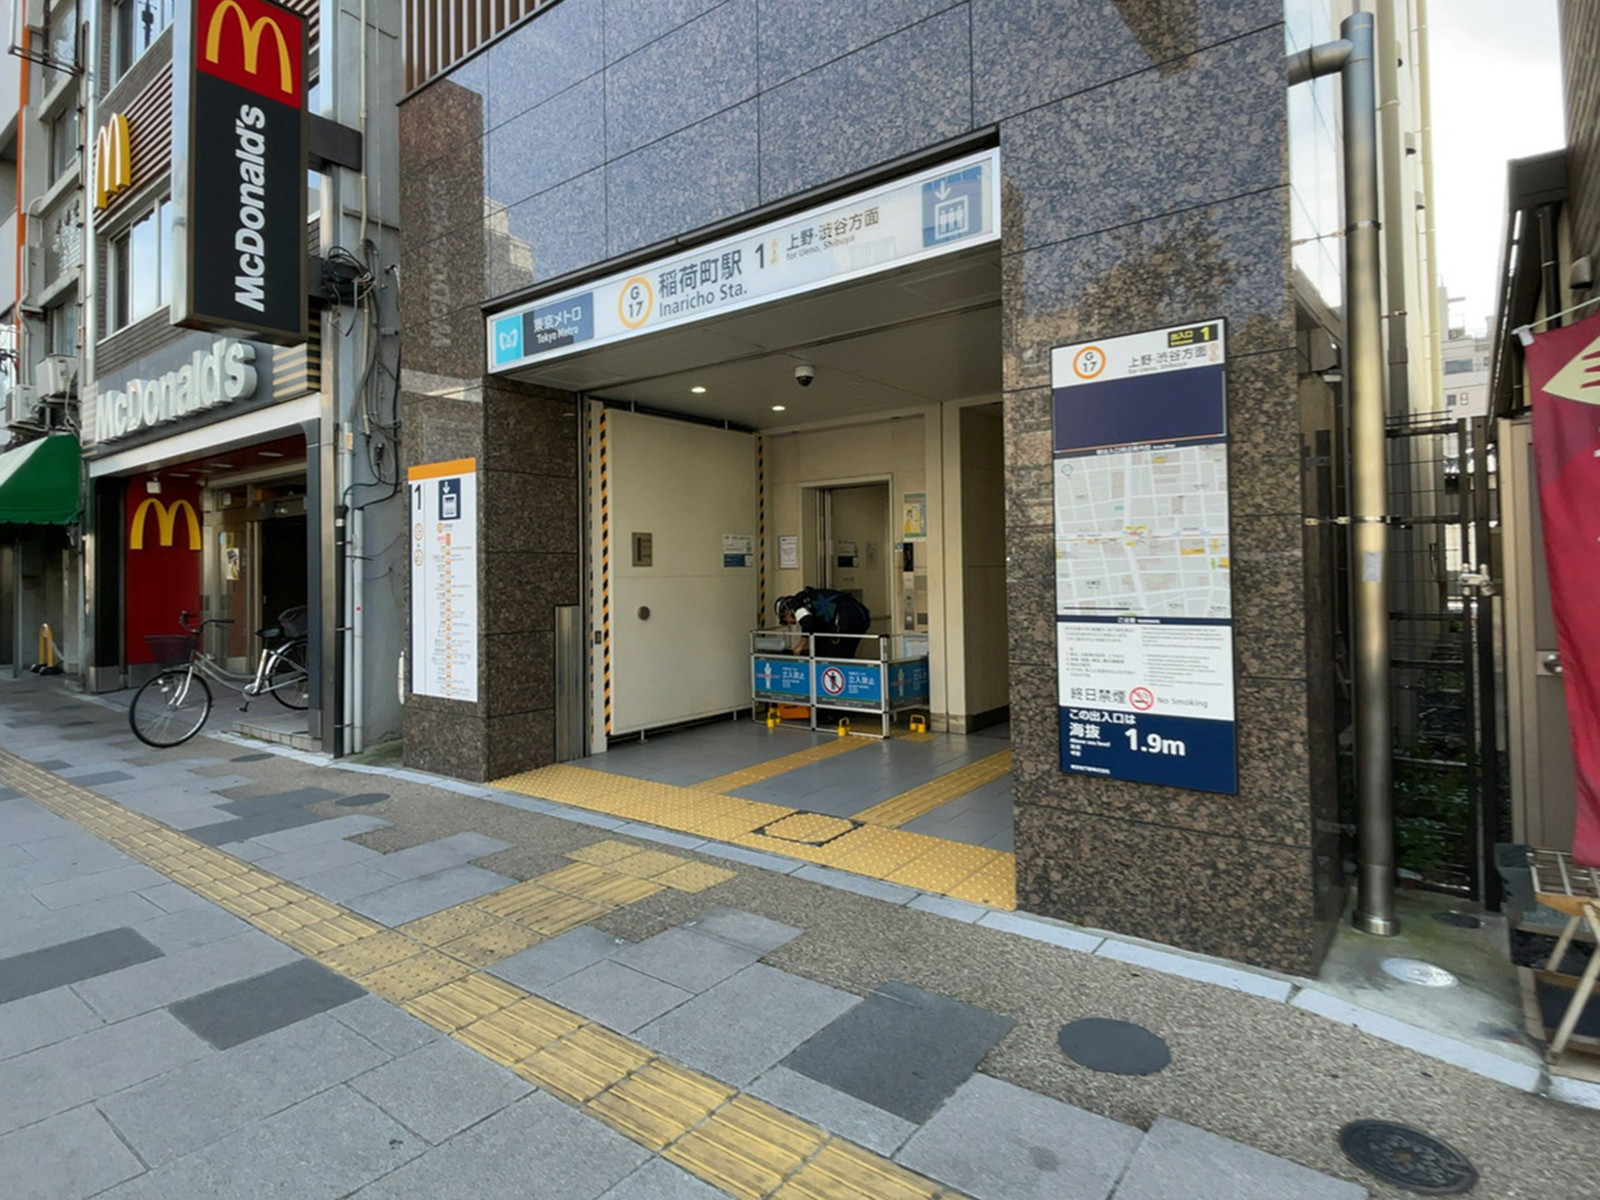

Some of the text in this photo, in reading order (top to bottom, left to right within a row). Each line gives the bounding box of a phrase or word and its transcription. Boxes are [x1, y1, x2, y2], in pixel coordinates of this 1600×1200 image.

[235, 103, 266, 312] McDonald's
[755, 243, 764, 269] 1
[658, 249, 742, 299] 稲荷町駅
[630, 285, 640, 300] G
[659, 282, 748, 317] Inaricho Sta.
[628, 301, 643, 318] 17
[533, 306, 582, 333] 東京メトロ
[537, 325, 580, 345] Tokyo Metro
[1200, 326, 1210, 341] 1
[1084, 351, 1094, 361] G
[1083, 361, 1097, 372] 17
[96, 338, 258, 443] McDonald's
[414, 484, 422, 510] 1
[1071, 687, 1126, 704] 終日禁煙
[1157, 696, 1208, 708] No Smoking
[1069, 709, 1137, 725] この出入口は
[1069, 722, 1101, 739] 海抜
[1125, 728, 1186, 756] 1.9m
